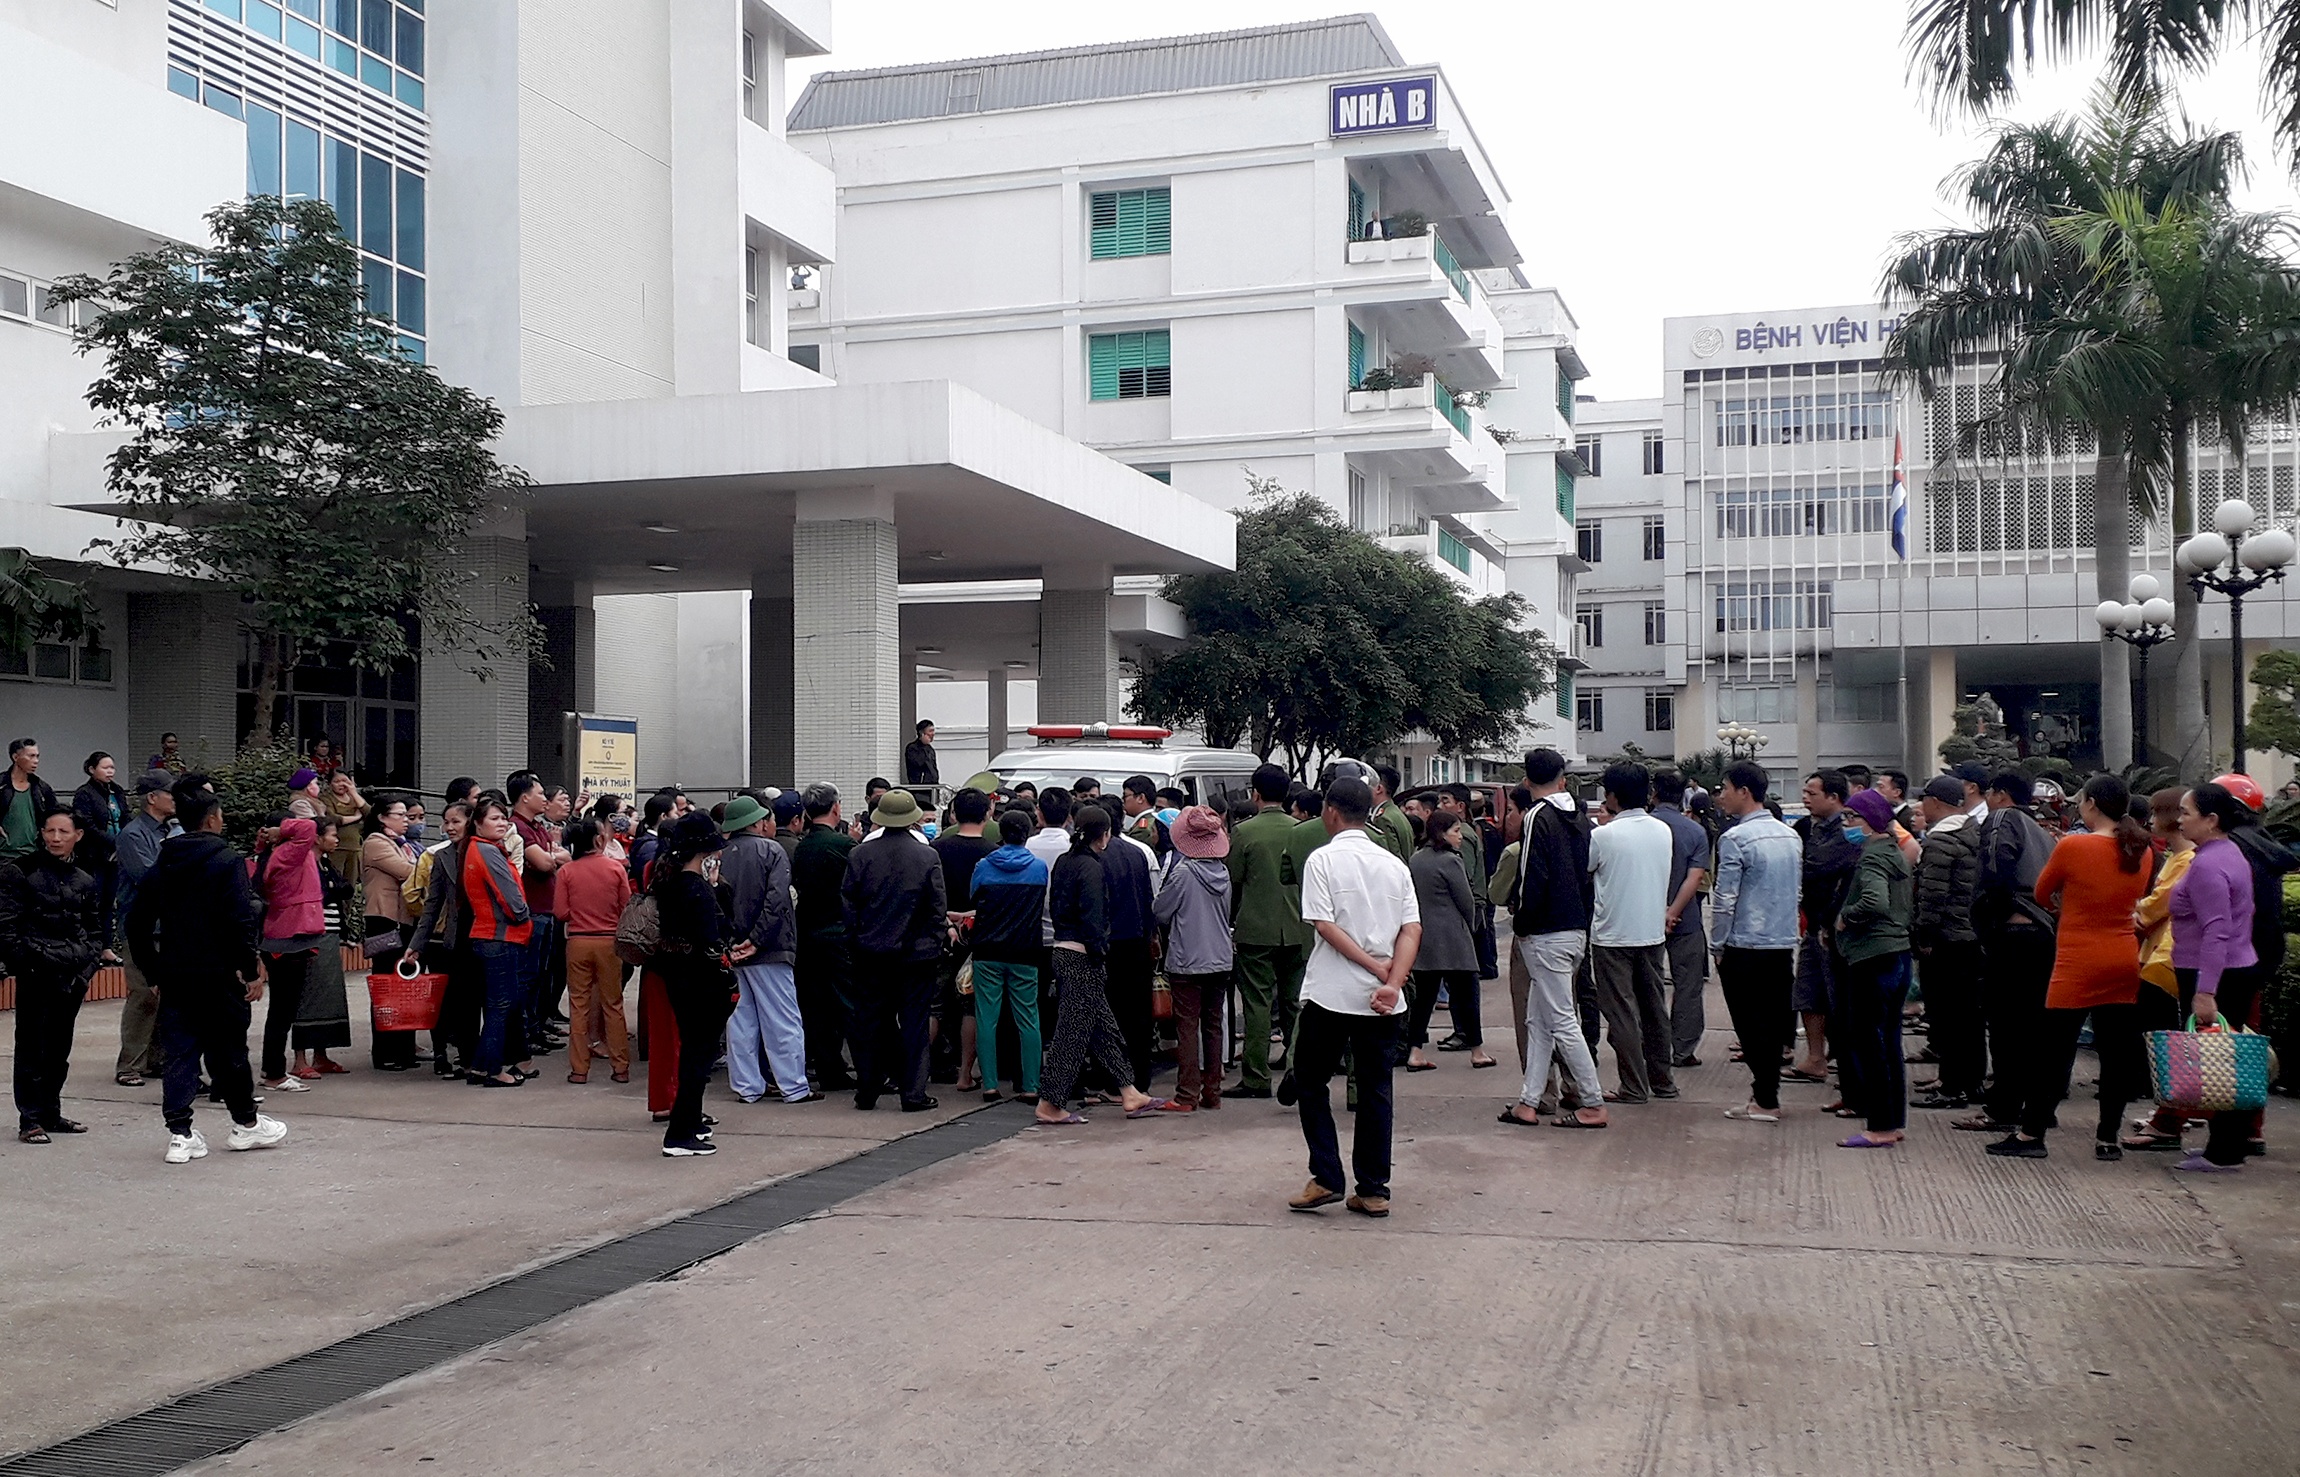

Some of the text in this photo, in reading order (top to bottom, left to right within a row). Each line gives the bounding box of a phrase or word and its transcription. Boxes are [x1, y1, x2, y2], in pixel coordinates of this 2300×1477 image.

[1339, 86, 1426, 128] NHÀ B
[1735, 321, 1802, 354] BỆNH
[1812, 316, 1868, 349] VIỆN
